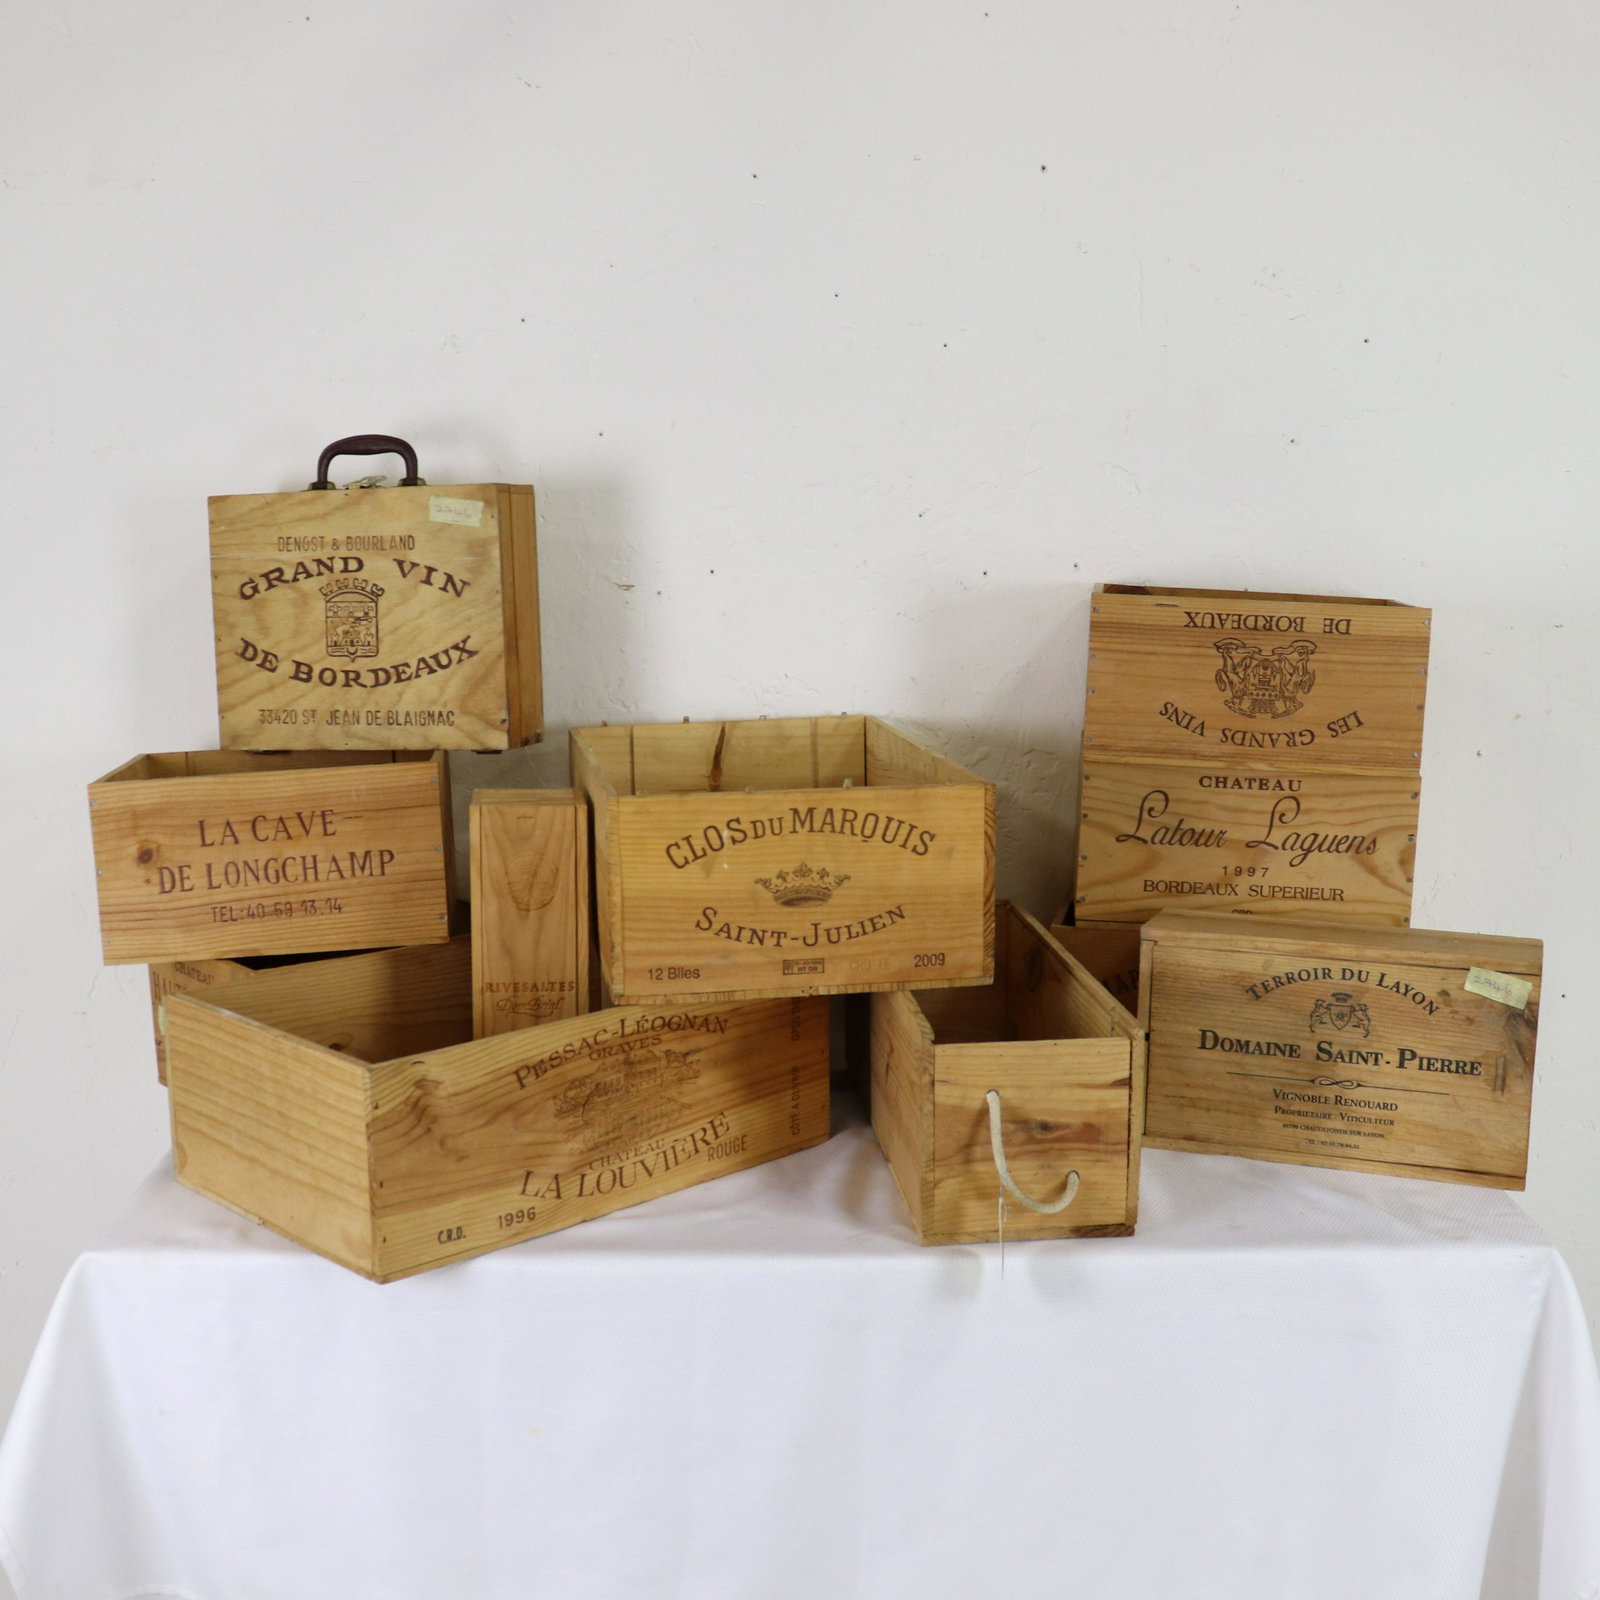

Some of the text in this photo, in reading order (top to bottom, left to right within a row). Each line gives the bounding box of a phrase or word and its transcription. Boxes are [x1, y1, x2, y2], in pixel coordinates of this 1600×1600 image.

[331, 537, 341, 551] &
[346, 534, 415, 552] BOURLAND
[238, 556, 471, 600] GRAND VIN
[1183, 611, 1352, 635] DE BORDEAUX
[234, 634, 479, 689] DE BORDEAUX
[258, 709, 298, 725] 33420
[325, 710, 361, 726] JEAN
[366, 710, 383, 726] DE
[387, 710, 455, 727] BLAIGNAC
[1158, 700, 1364, 748] LES GRANDS VINS
[1198, 775, 1304, 792] CHATEAU
[197, 809, 338, 848] LA CAVE
[665, 806, 937, 869] CLOS DU MARQUIS
[1115, 789, 1380, 868] Latour Laguens
[157, 848, 396, 895] DE LONGCHAMP
[1221, 865, 1270, 878] 1997
[1143, 879, 1345, 902] BORDEAUX SUPERIEUR
[694, 905, 906, 948] SAINT-JULIEN
[913, 952, 946, 968] 2009
[485, 981, 575, 994] RIVESALTES
[648, 968, 664, 981] 12
[1245, 966, 1440, 1016] TERROIR DU LAYON
[588, 1033, 663, 1063] GRAVES
[1198, 1028, 1301, 1059] DOMAINE
[1272, 1088, 1399, 1112] VIGNOBLE RENOUARD
[1274, 1105, 1332, 1120] PROPRIETAIRE
[1339, 1112, 1396, 1126] VITICULTEUR
[707, 1133, 748, 1164] ROUGE
[519, 1170, 564, 1200] LA
[498, 1205, 537, 1230] 1996
[437, 1226, 467, 1246] C.R.D.
